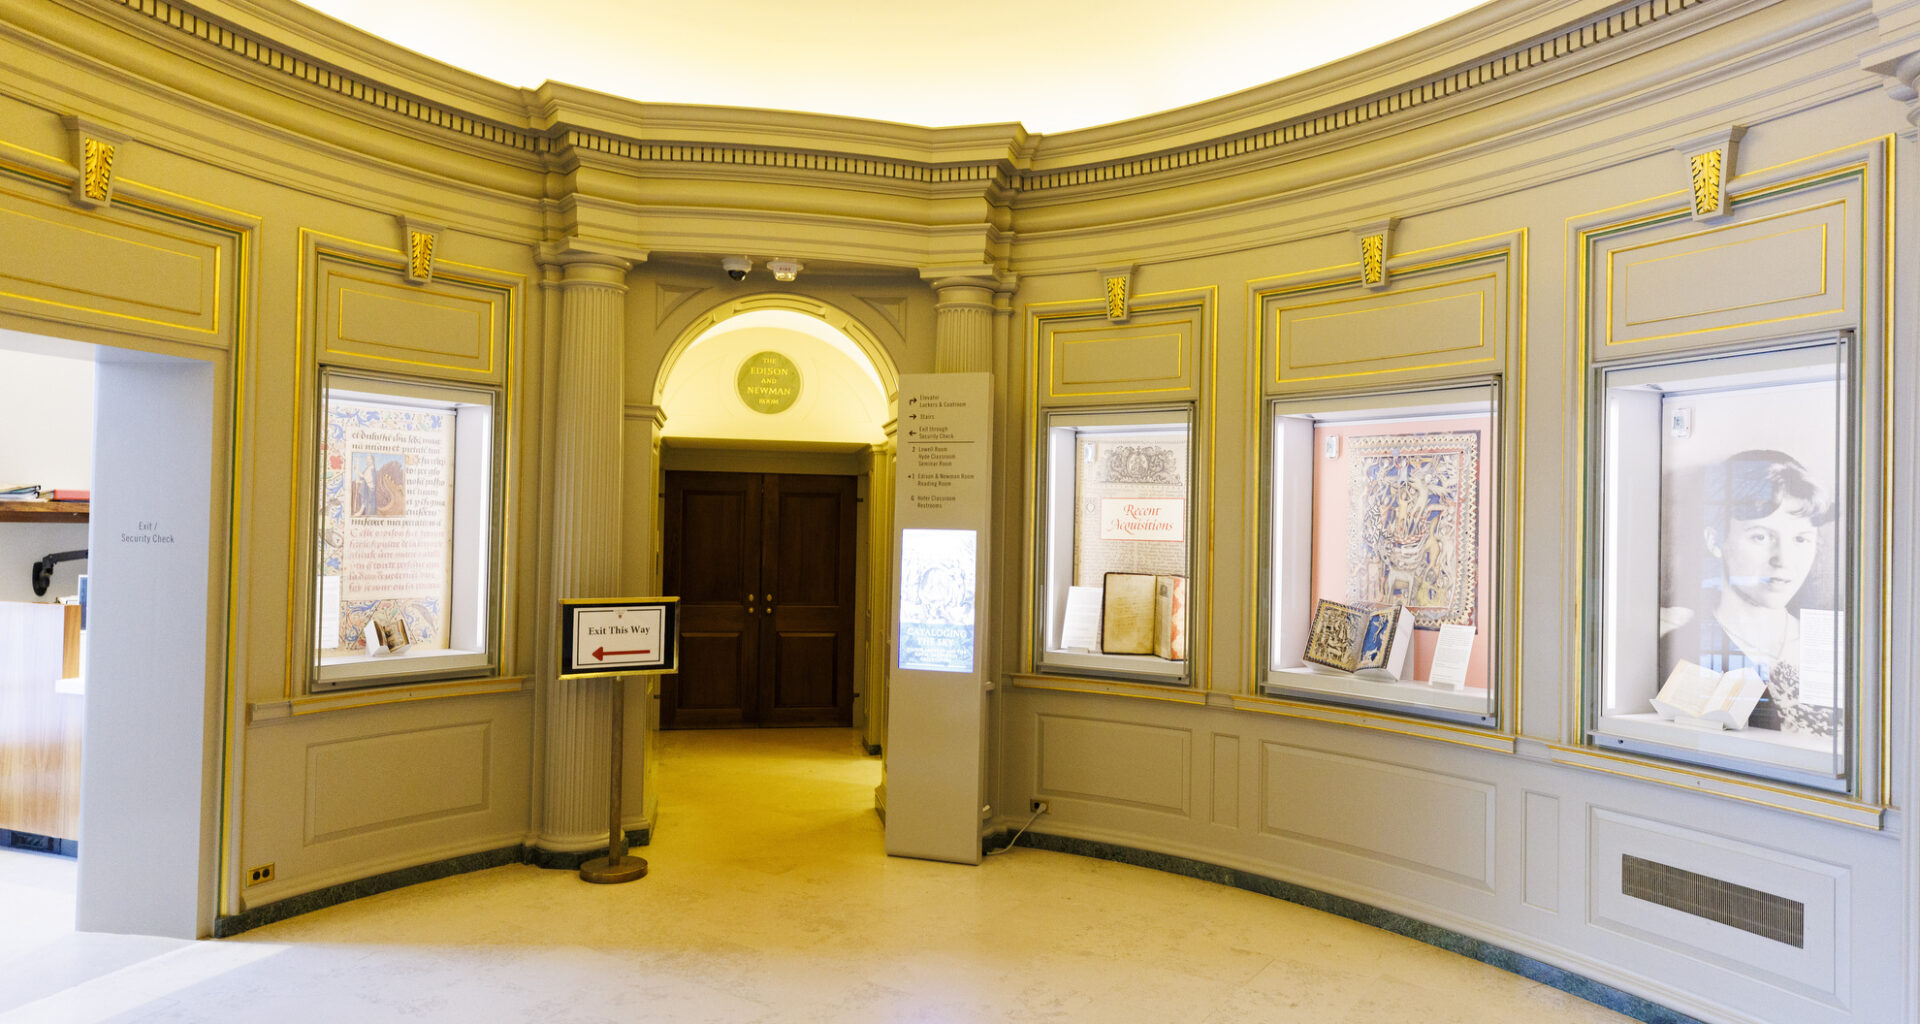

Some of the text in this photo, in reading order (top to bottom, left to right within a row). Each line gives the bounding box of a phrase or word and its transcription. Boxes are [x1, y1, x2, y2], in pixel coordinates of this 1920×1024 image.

[750, 367, 789, 376] EDISON
[747, 386, 791, 395] NEWMAN
[1123, 504, 1162, 519] Recent
[138, 521, 152, 531] Exit
[1106, 518, 1173, 535] Acquisitions
[121, 533, 175, 544] Security Check
[588, 624, 651, 635] Exit This Way
[907, 627, 967, 638] CATALOGING
